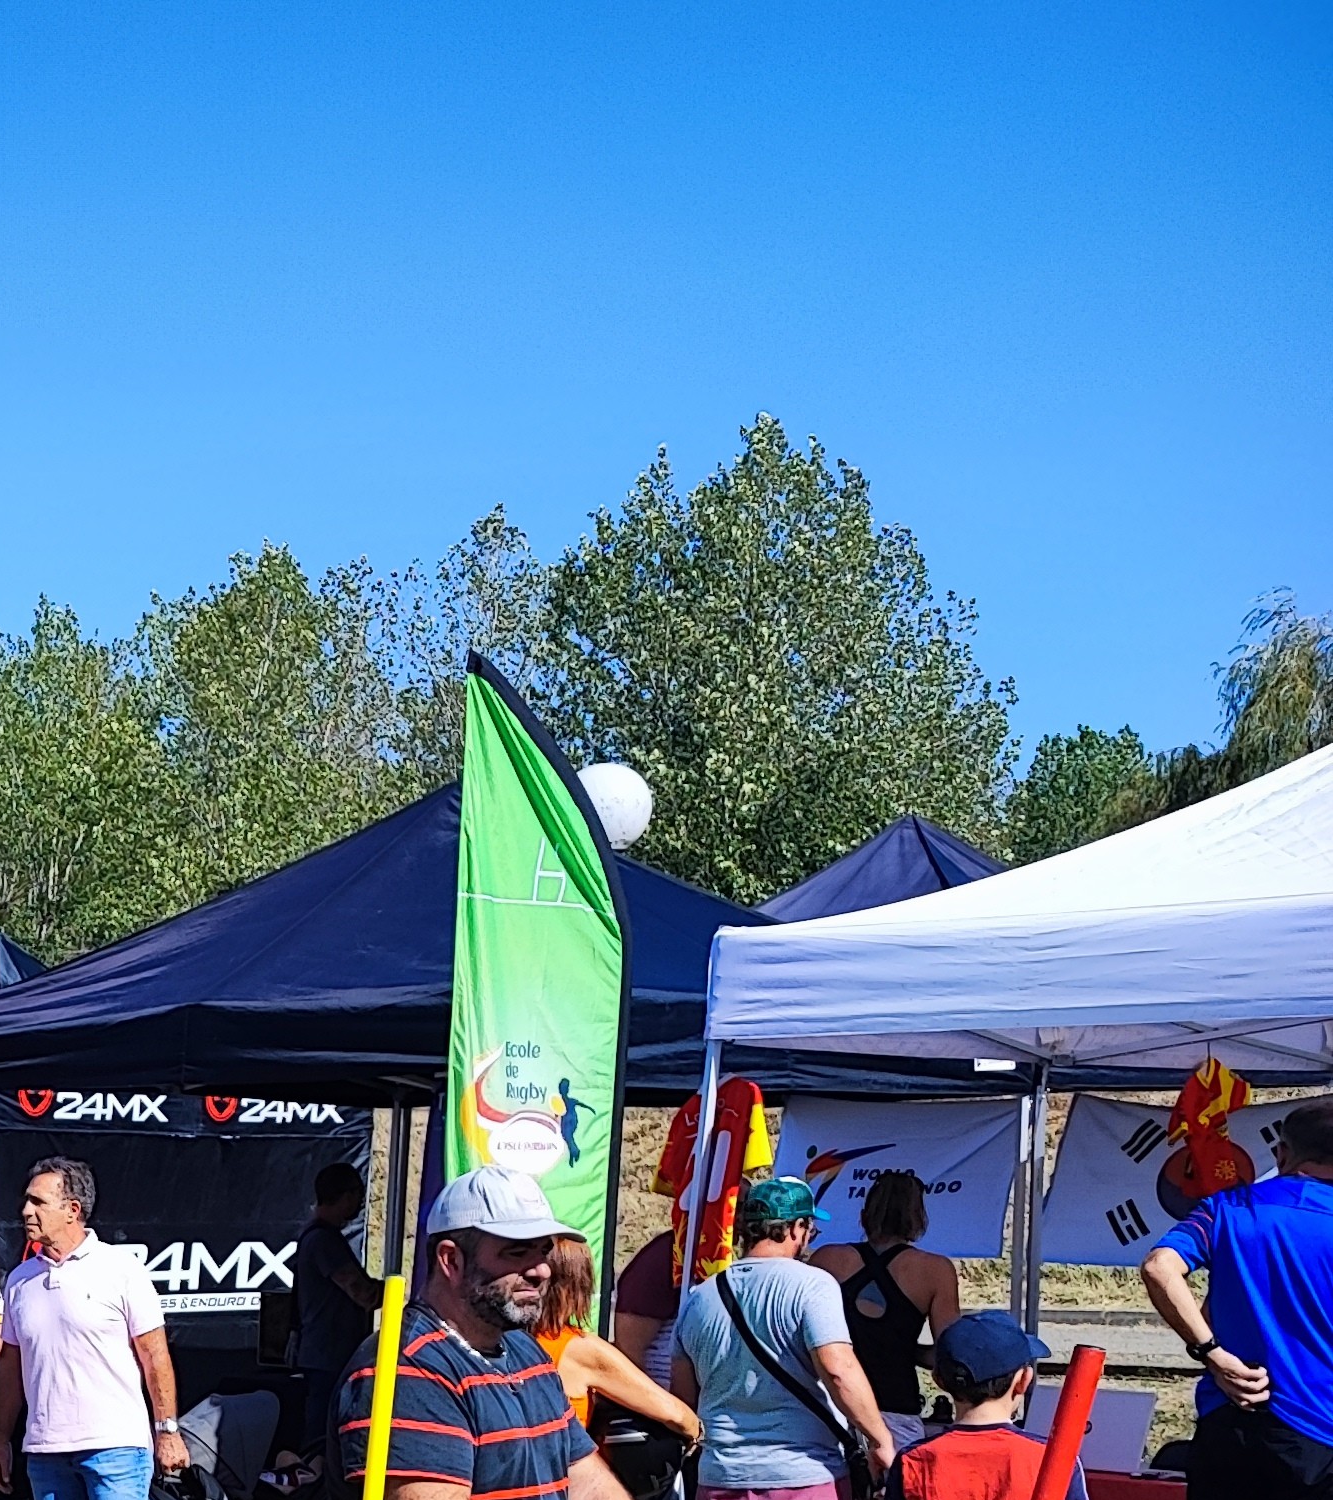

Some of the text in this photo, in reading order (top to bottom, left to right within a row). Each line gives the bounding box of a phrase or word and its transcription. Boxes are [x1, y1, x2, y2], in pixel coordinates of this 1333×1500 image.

[505, 1040, 541, 1059] Ecole
[506, 1062, 519, 1078] de
[506, 1082, 548, 1104] Rugby
[53, 1091, 169, 1123] 24MX
[238, 1098, 345, 1124] 24MX
[189, 1296, 247, 1308] ENDURO
